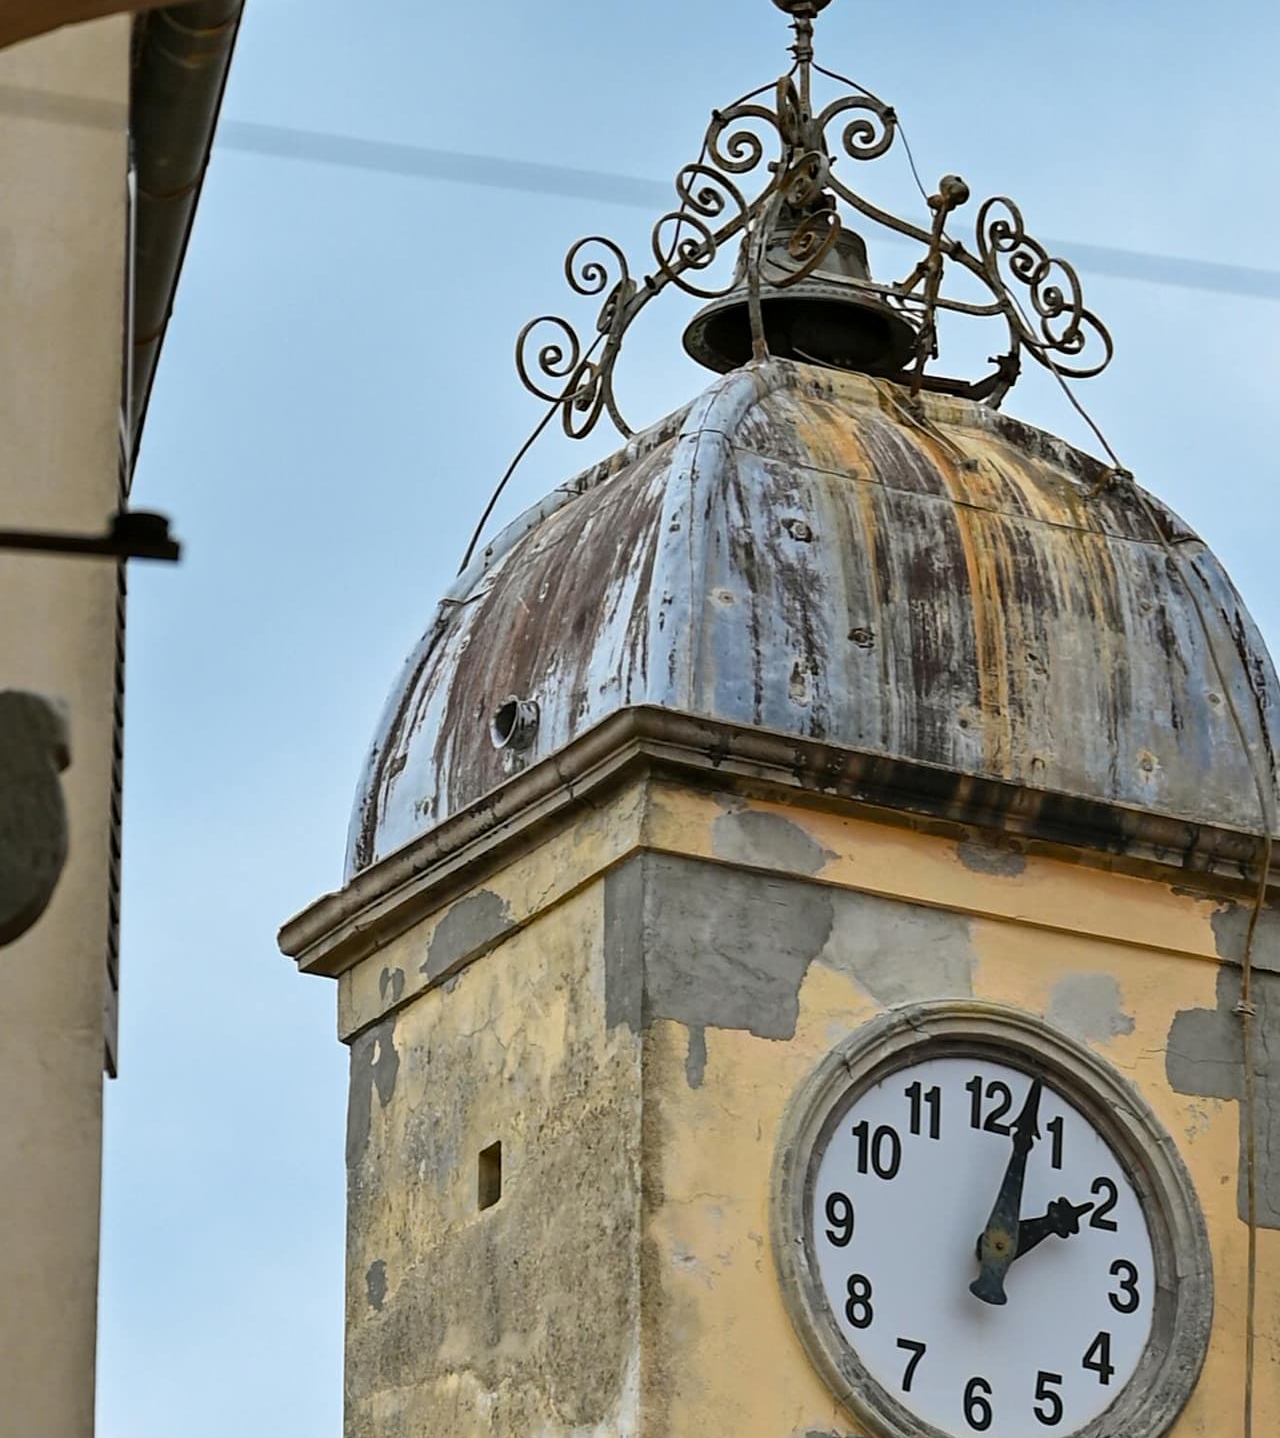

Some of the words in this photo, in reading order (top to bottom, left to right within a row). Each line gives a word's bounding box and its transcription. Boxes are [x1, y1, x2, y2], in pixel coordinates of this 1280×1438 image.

[904, 1081, 941, 1140] 11
[966, 1075, 1012, 1136] 12
[851, 1120, 902, 1181] 10
[1046, 1115, 1064, 1170] 1
[825, 1191, 855, 1248] 9
[1089, 1176, 1119, 1233] 2
[845, 1273, 874, 1330] 8
[1108, 1259, 1140, 1314] 3
[896, 1337, 927, 1393] 7
[1082, 1331, 1115, 1386] 4
[963, 1376, 993, 1432] 6
[1033, 1370, 1063, 1426] 5
